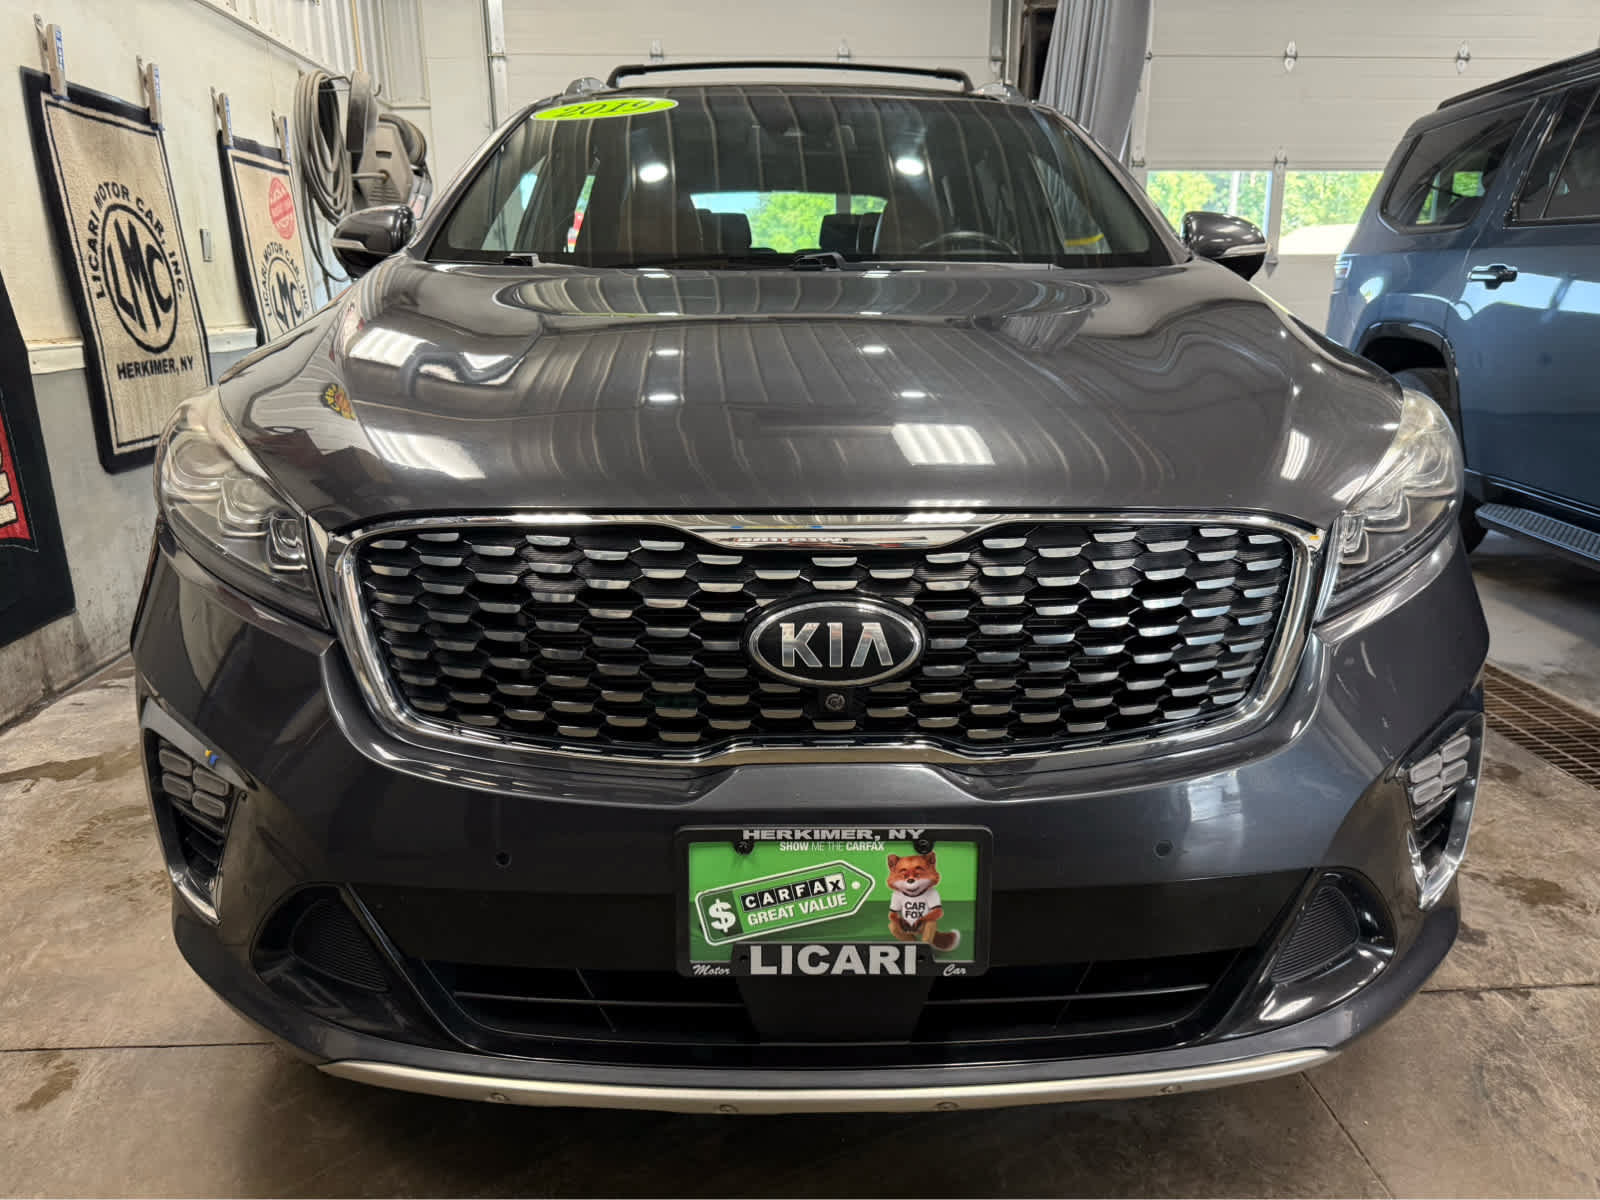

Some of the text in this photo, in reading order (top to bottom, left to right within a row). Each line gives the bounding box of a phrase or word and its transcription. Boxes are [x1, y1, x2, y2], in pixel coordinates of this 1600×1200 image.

[554, 100, 655, 118] 2019
[94, 181, 131, 209] MOTOR
[87, 209, 106, 300] LICARI
[107, 217, 174, 333] LMC
[168, 250, 185, 299] INC.
[271, 271, 302, 329] LMC
[116, 355, 194, 381] HERKIMER, NY
[779, 622, 894, 668] KIA
[742, 829, 927, 842] HERKIMER, NY
[779, 841, 885, 852] SHOW ME THE CARFAX
[742, 873, 847, 911] CARFAX
[904, 901, 926, 911] CAR
[747, 892, 848, 926] GREAT VALUE
[904, 910, 925, 920] FOX
[692, 963, 731, 976] Motor
[750, 945, 918, 975] LICARI
[943, 963, 967, 977] Car
